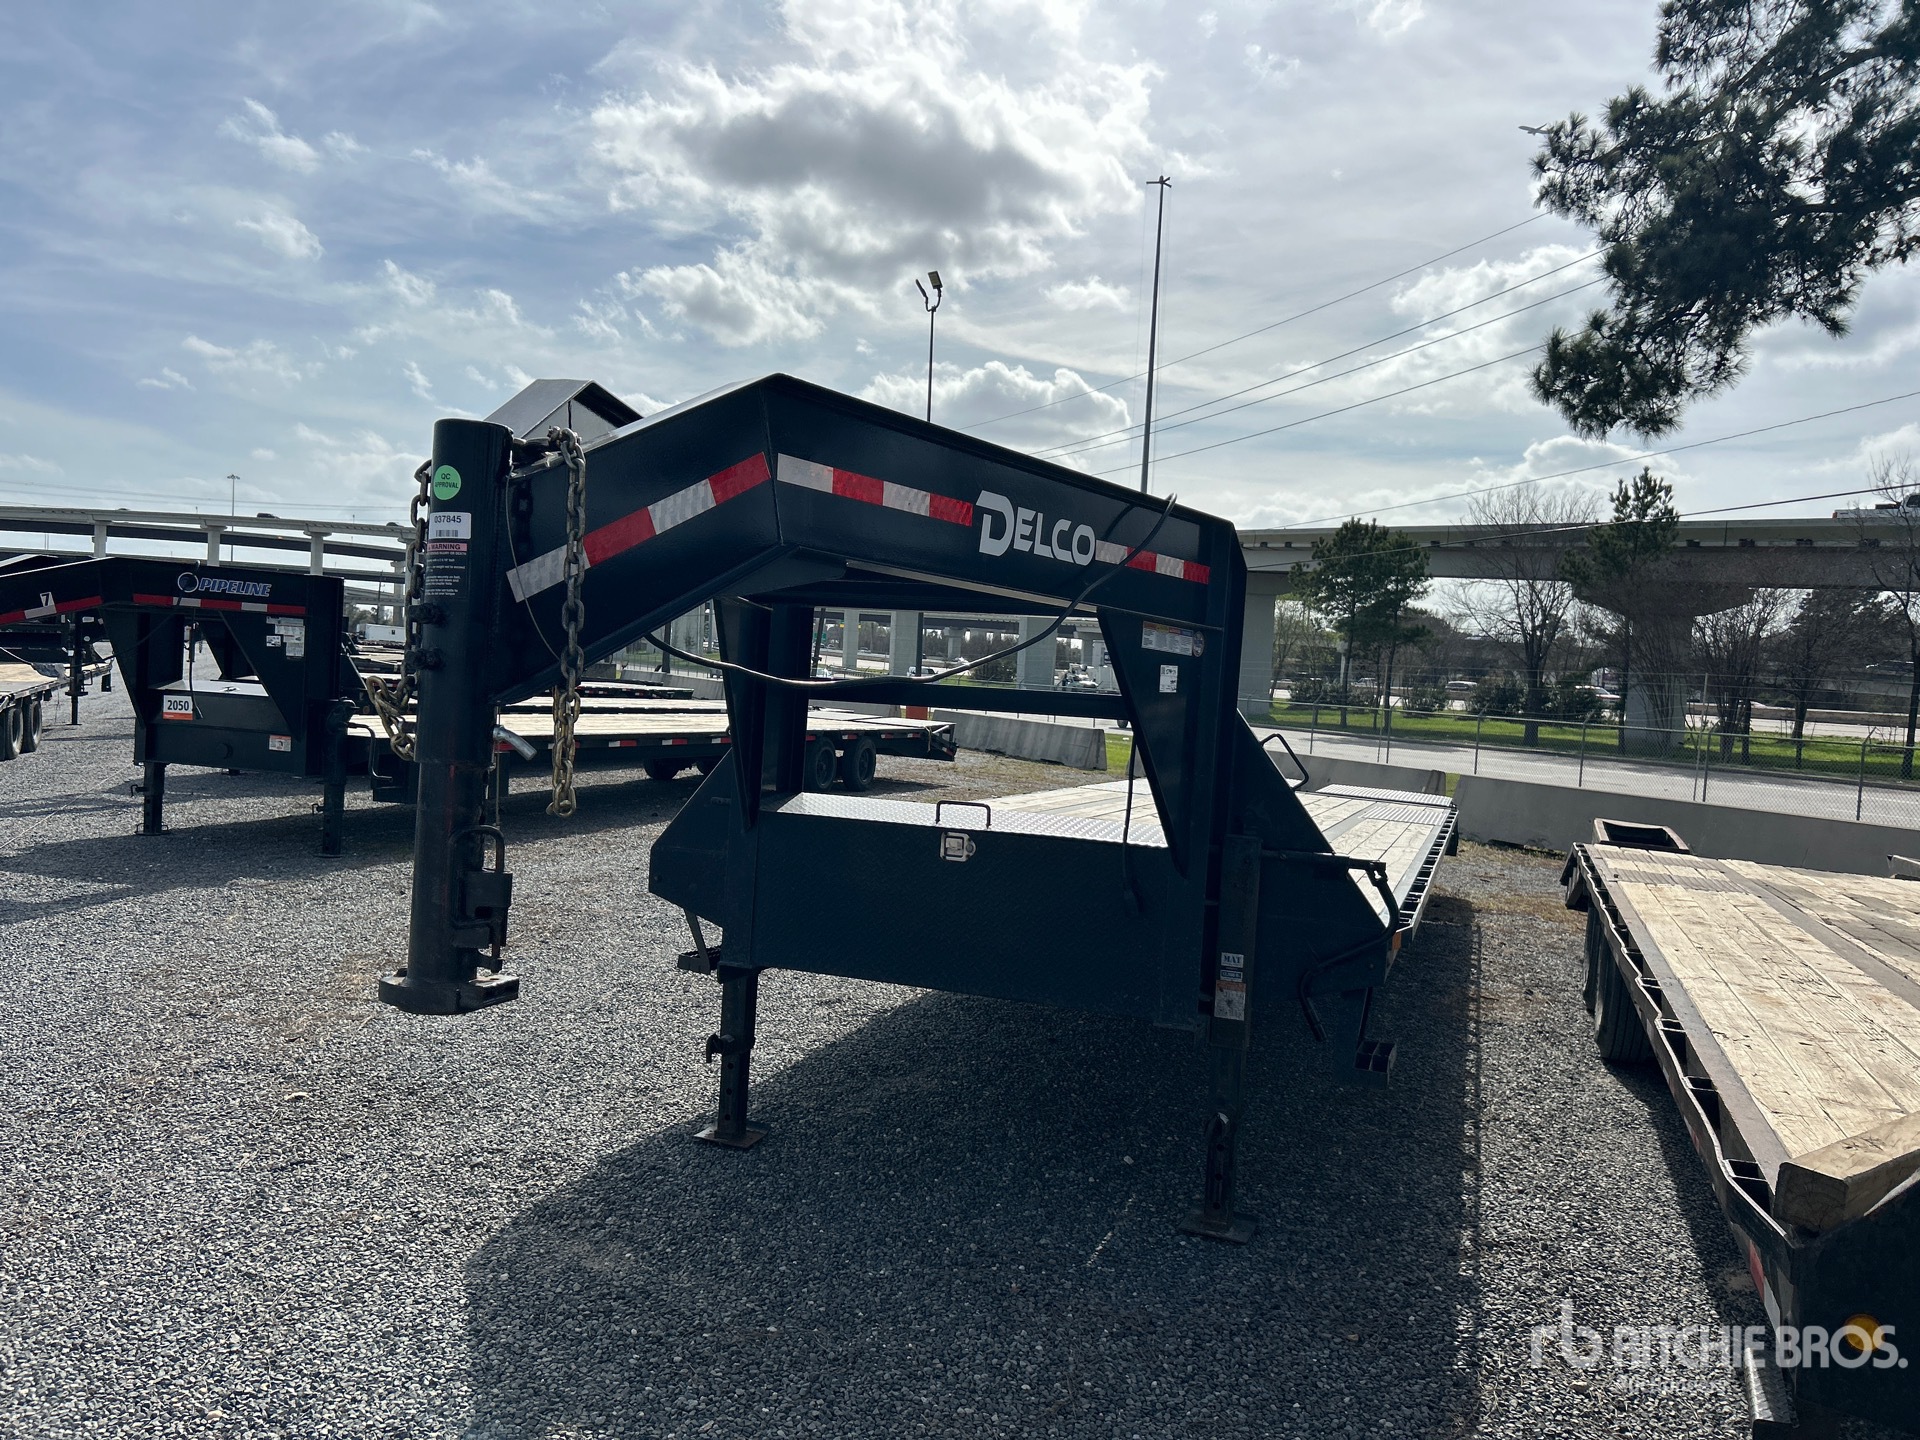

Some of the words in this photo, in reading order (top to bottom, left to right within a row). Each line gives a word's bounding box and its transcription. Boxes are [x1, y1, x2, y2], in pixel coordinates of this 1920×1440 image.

[434, 515, 462, 523] 037845
[976, 490, 1095, 566] DELCO
[199, 578, 272, 597] PIPELINE
[41, 593, 50, 607] 7
[167, 699, 190, 711] 2050
